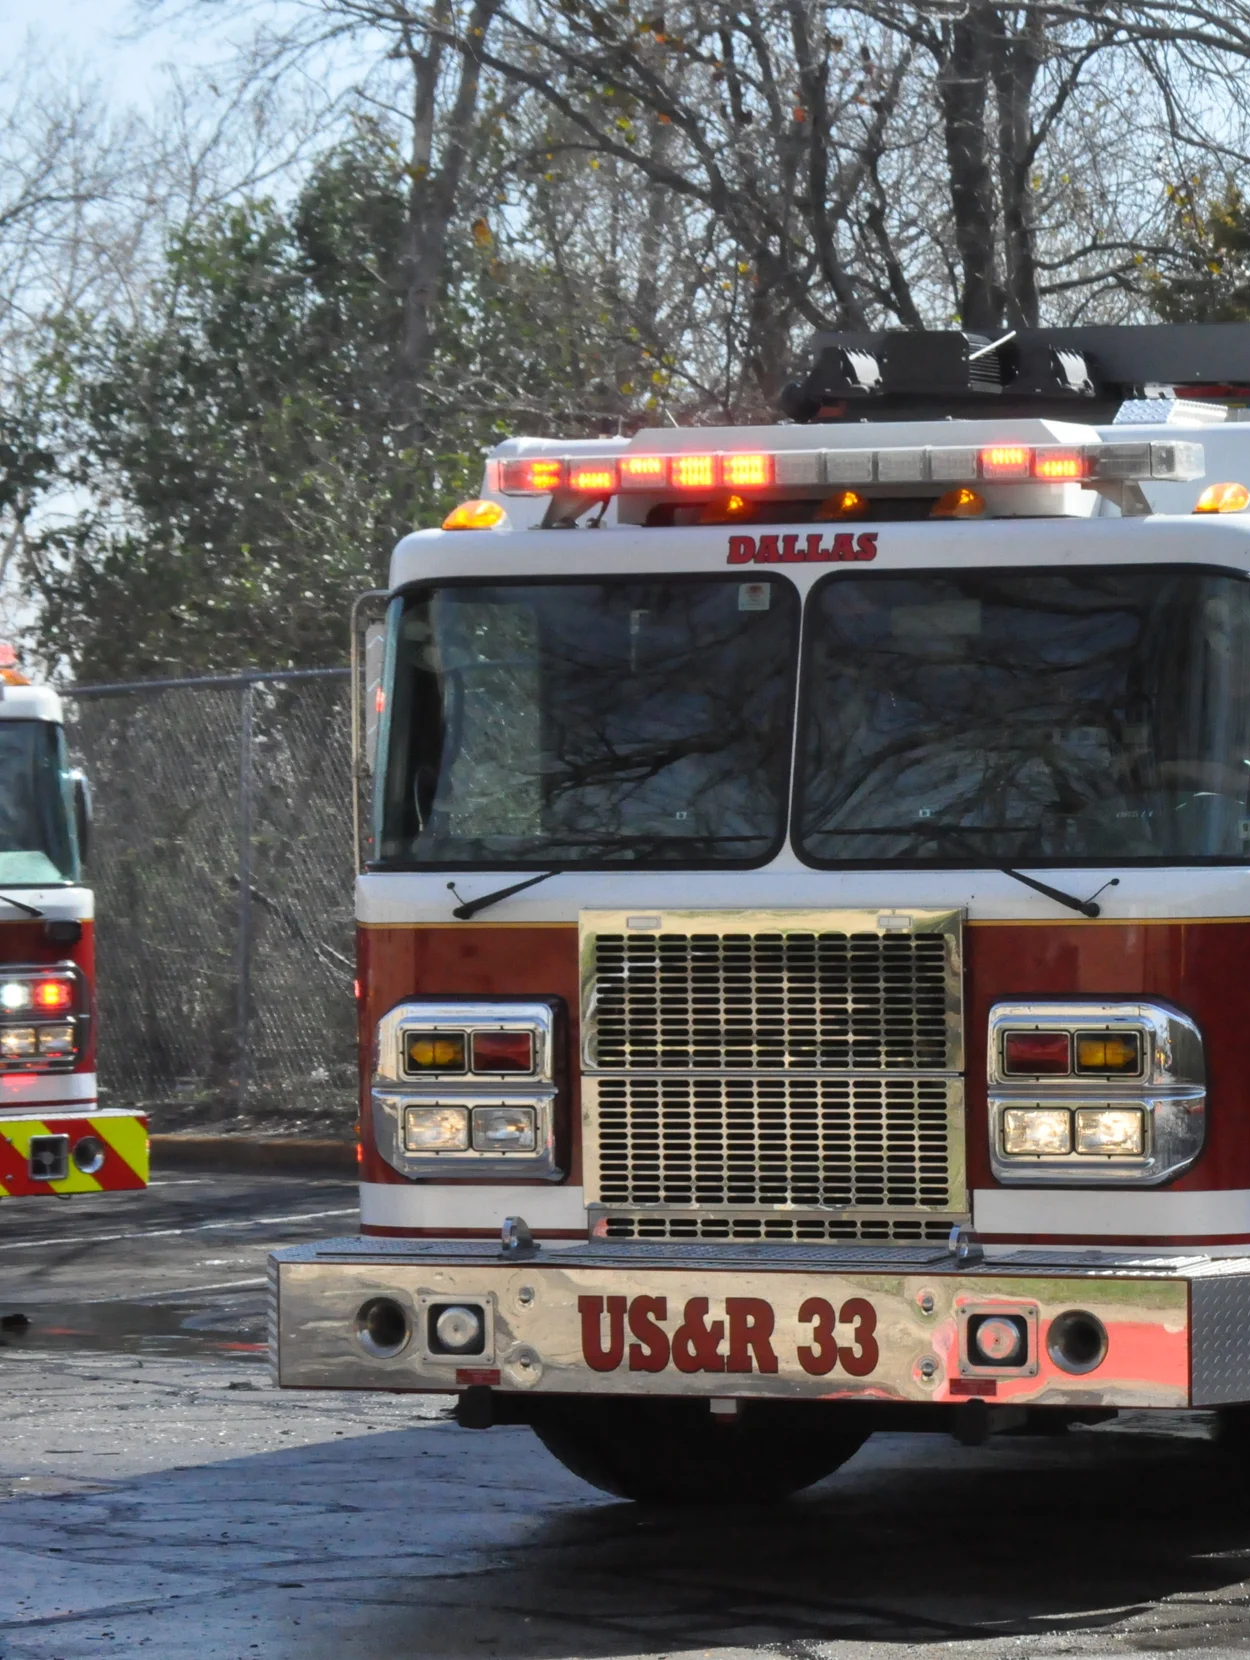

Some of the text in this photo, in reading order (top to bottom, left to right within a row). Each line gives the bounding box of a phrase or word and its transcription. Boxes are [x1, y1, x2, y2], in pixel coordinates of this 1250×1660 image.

[726, 532, 879, 564] DALLAS
[578, 1294, 879, 1377] US&R 33
